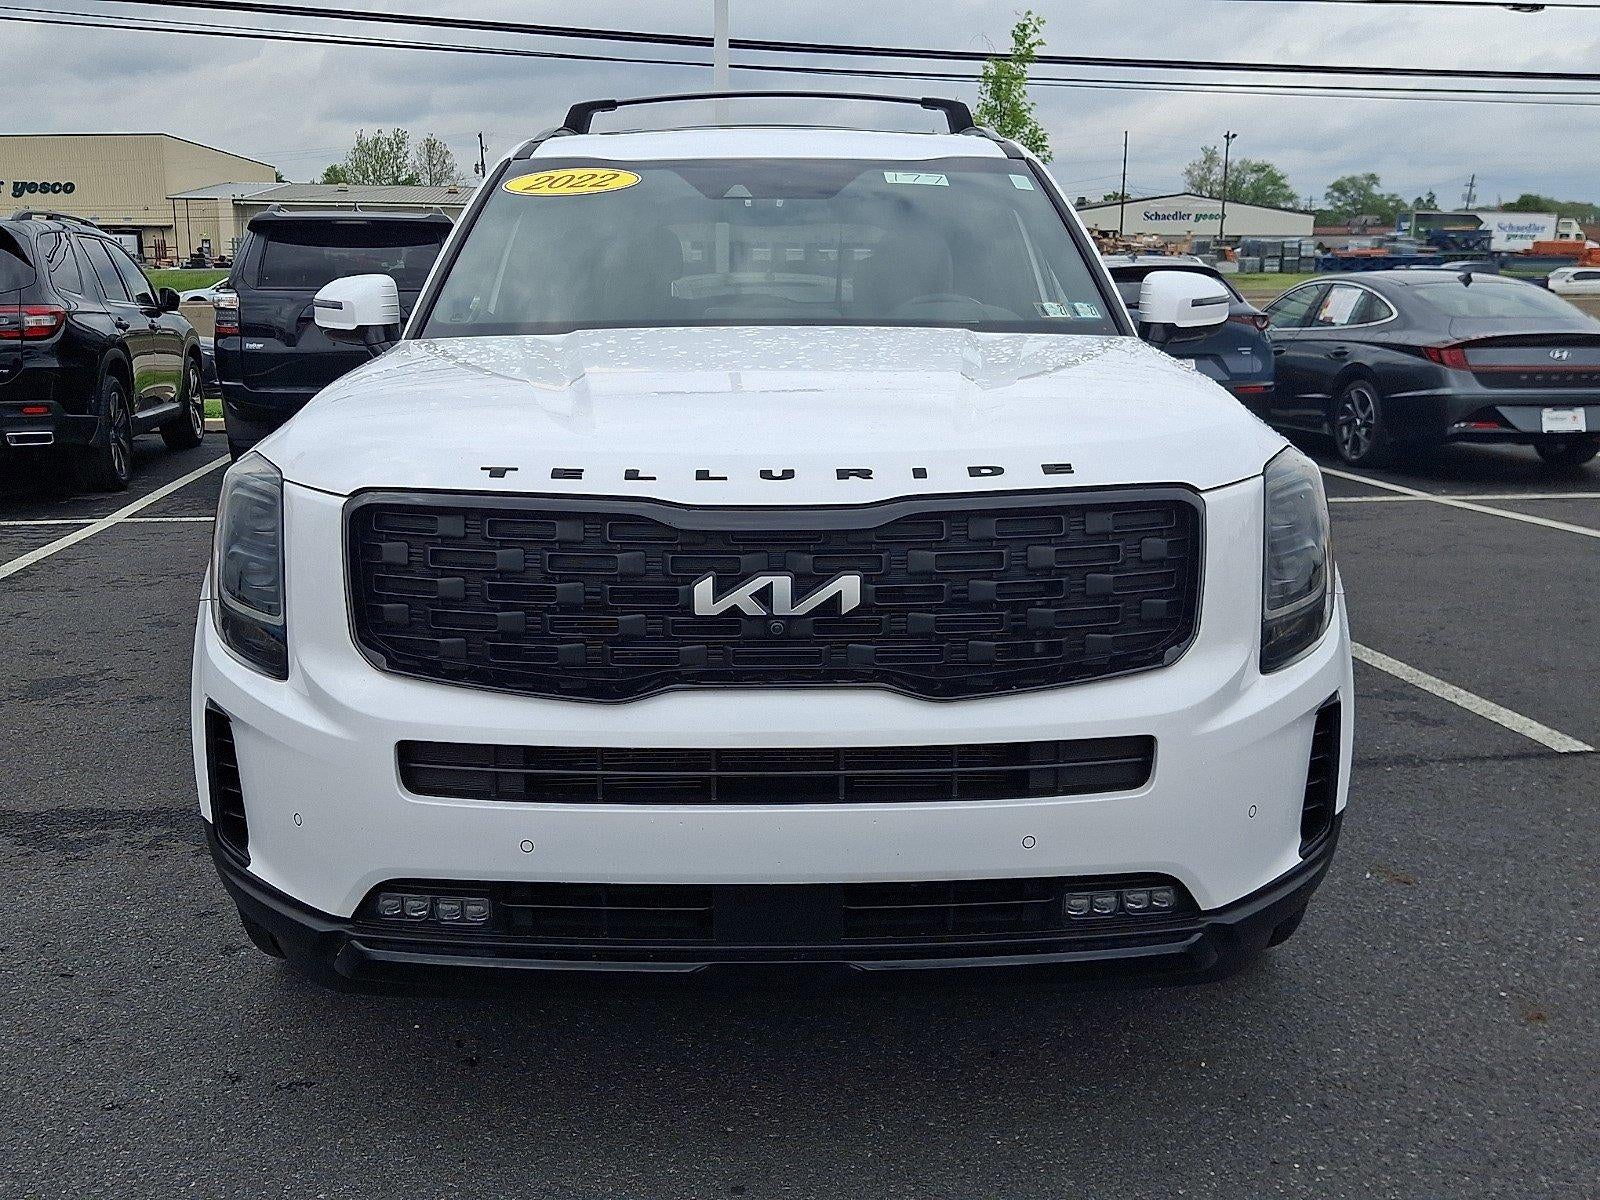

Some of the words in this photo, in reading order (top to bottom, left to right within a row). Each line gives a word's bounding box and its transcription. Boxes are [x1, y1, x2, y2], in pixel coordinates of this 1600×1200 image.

[11, 181, 76, 198] yesco
[522, 173, 620, 191] 2022
[1143, 211, 1192, 221] Schaedler
[480, 463, 1075, 480] TELLURIDE
